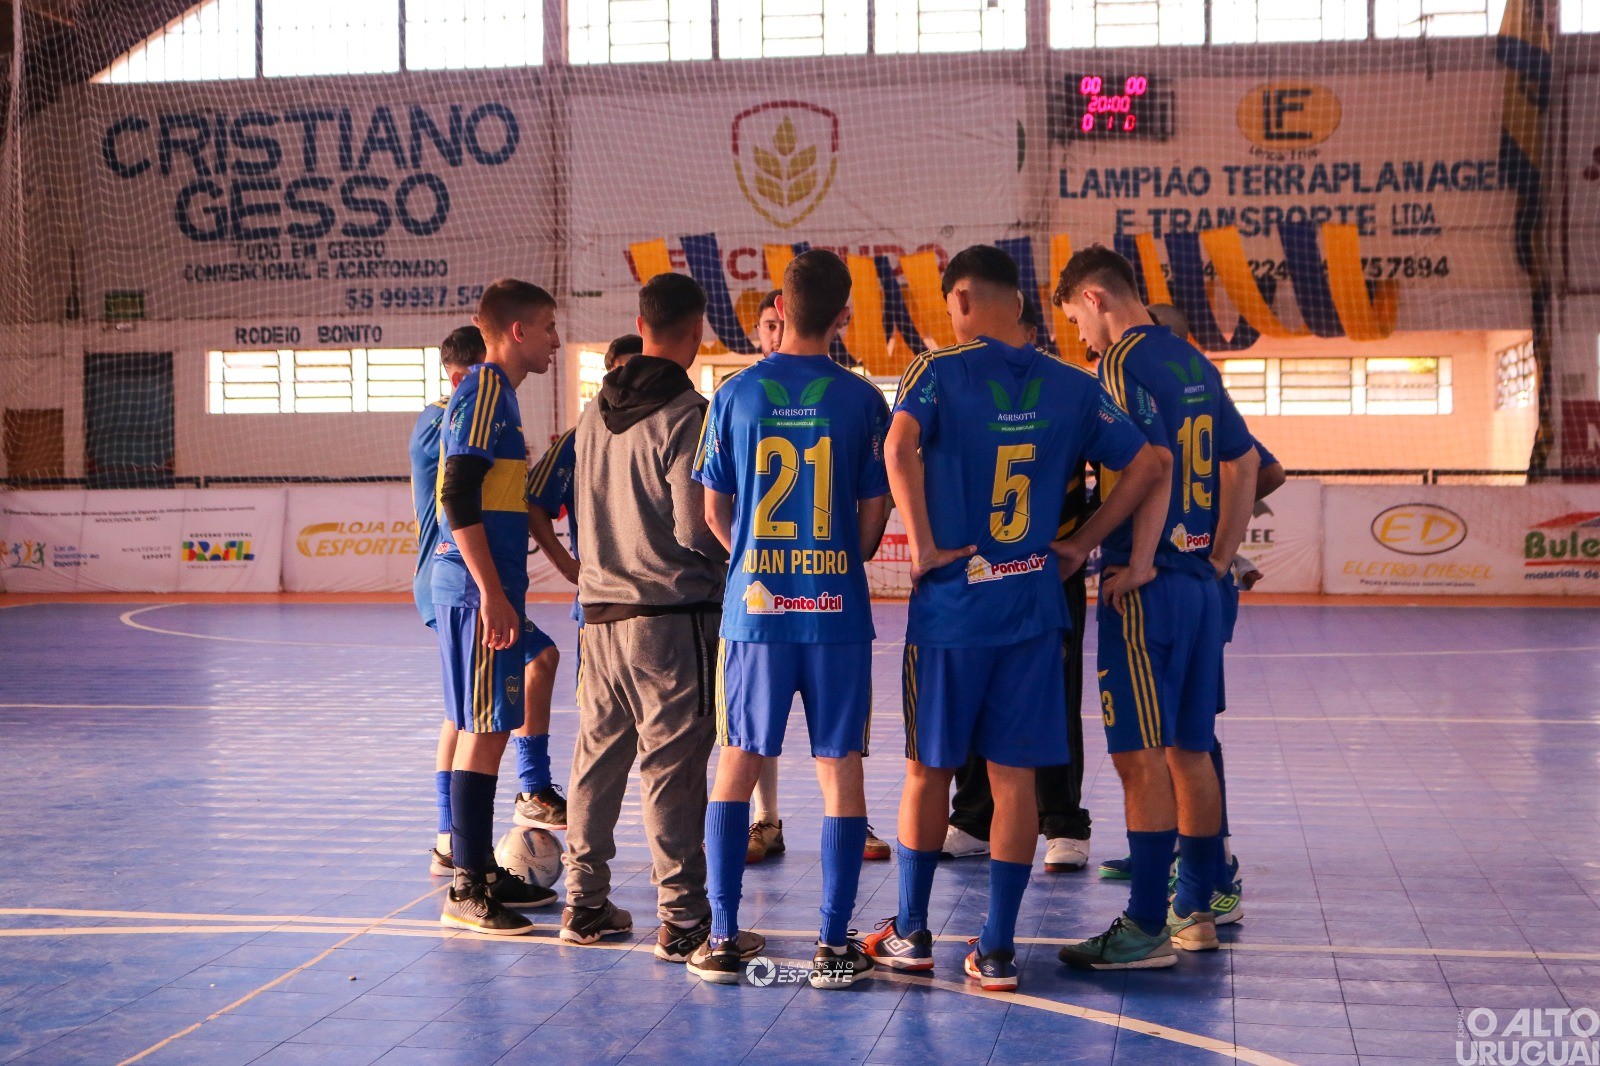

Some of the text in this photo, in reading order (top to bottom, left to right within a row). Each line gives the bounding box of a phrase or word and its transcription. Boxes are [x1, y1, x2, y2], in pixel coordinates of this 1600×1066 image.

[1080, 76, 1147, 96] 00 00
[1087, 95, 1131, 113] 20:00
[102, 102, 520, 179] CRISTIANO
[173, 172, 451, 242] GESSO
[1391, 202, 1435, 225] LTDA
[233, 241, 386, 261] TUDO EM GESSO
[184, 262, 312, 284] CONVENCIONAL
[335, 258, 449, 280] ACARTONADO
[235, 324, 383, 345] RODEIO BONITO
[772, 408, 817, 417] AGRISOTTI
[997, 411, 1036, 421] AGRISOTTI
[1177, 414, 1213, 514] 19
[754, 436, 833, 540] 21
[989, 443, 1036, 543] 5
[338, 521, 385, 534] LOJA
[1186, 533, 1209, 548] Pont
[181, 540, 255, 562] BRASIL
[791, 549, 848, 575] PEDRO
[990, 559, 1029, 576] Ponto
[1342, 560, 1496, 580] ELETRO DIESEL
[1524, 568, 1580, 580] materiais
[773, 591, 842, 611] Ponto Útil
